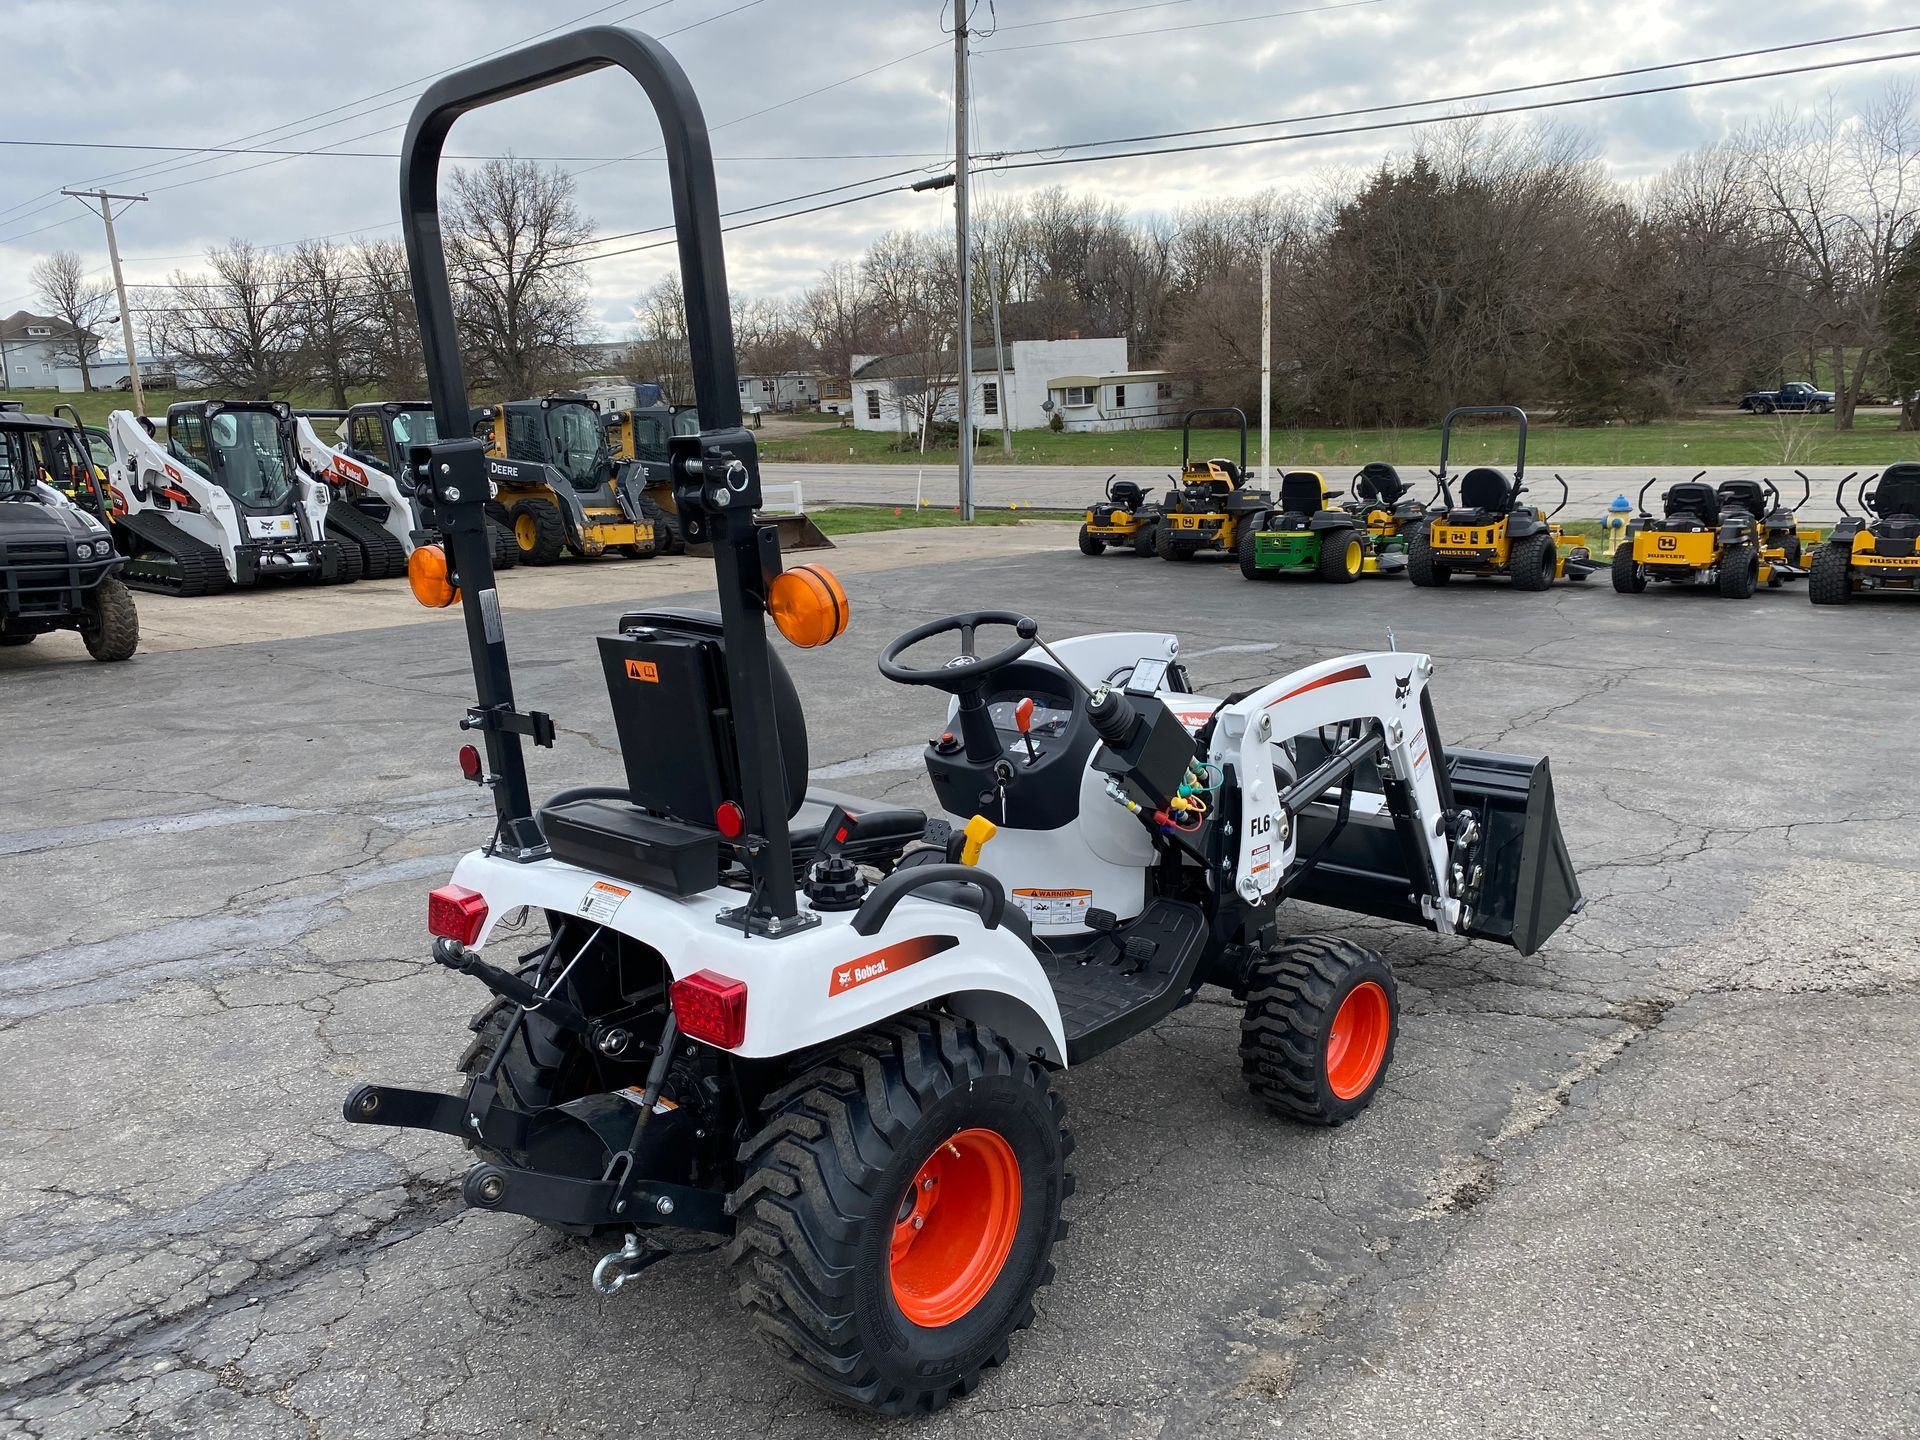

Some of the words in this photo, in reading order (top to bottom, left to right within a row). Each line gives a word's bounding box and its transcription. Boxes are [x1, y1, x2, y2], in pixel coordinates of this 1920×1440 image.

[491, 462, 519, 477] DEERE
[1251, 814, 1270, 837] FL6
[854, 959, 887, 982] Bobcat
